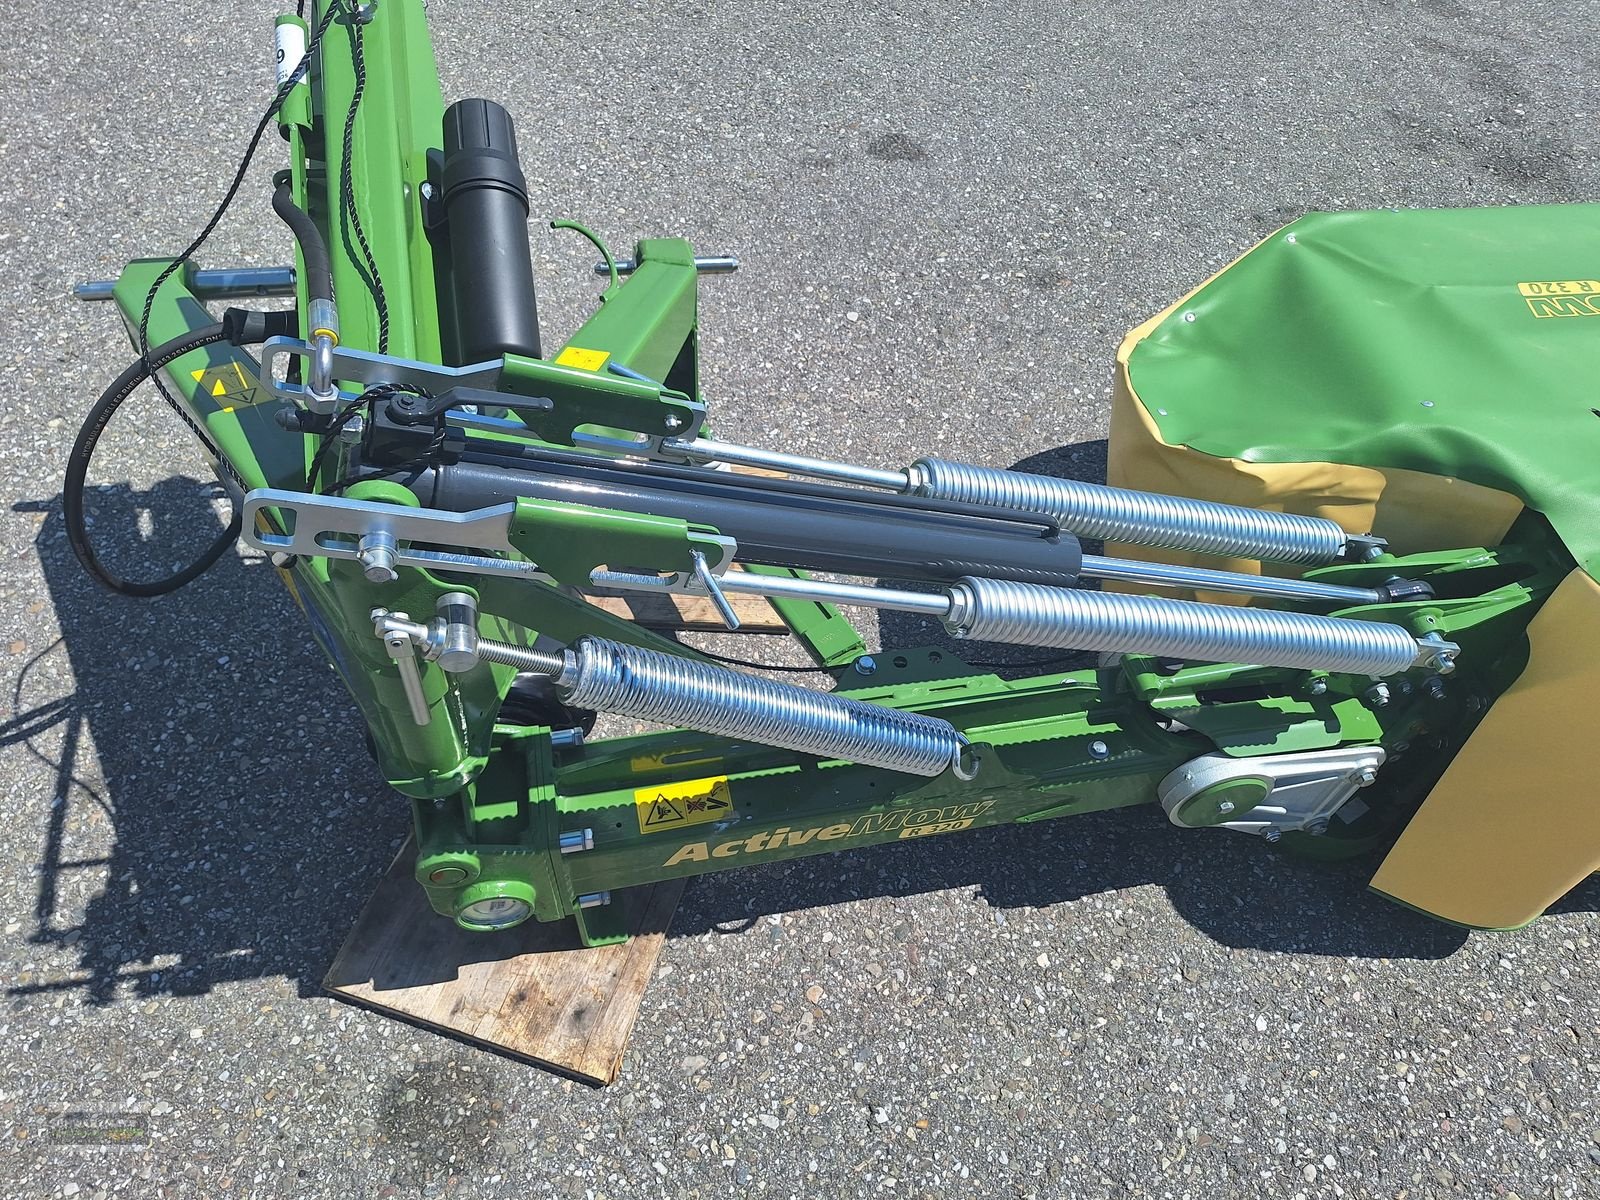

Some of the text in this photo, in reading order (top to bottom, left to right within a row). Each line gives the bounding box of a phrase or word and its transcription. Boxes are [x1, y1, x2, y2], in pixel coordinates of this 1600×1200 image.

[1528, 281, 1594, 294] R 320
[908, 821, 963, 838] R 320
